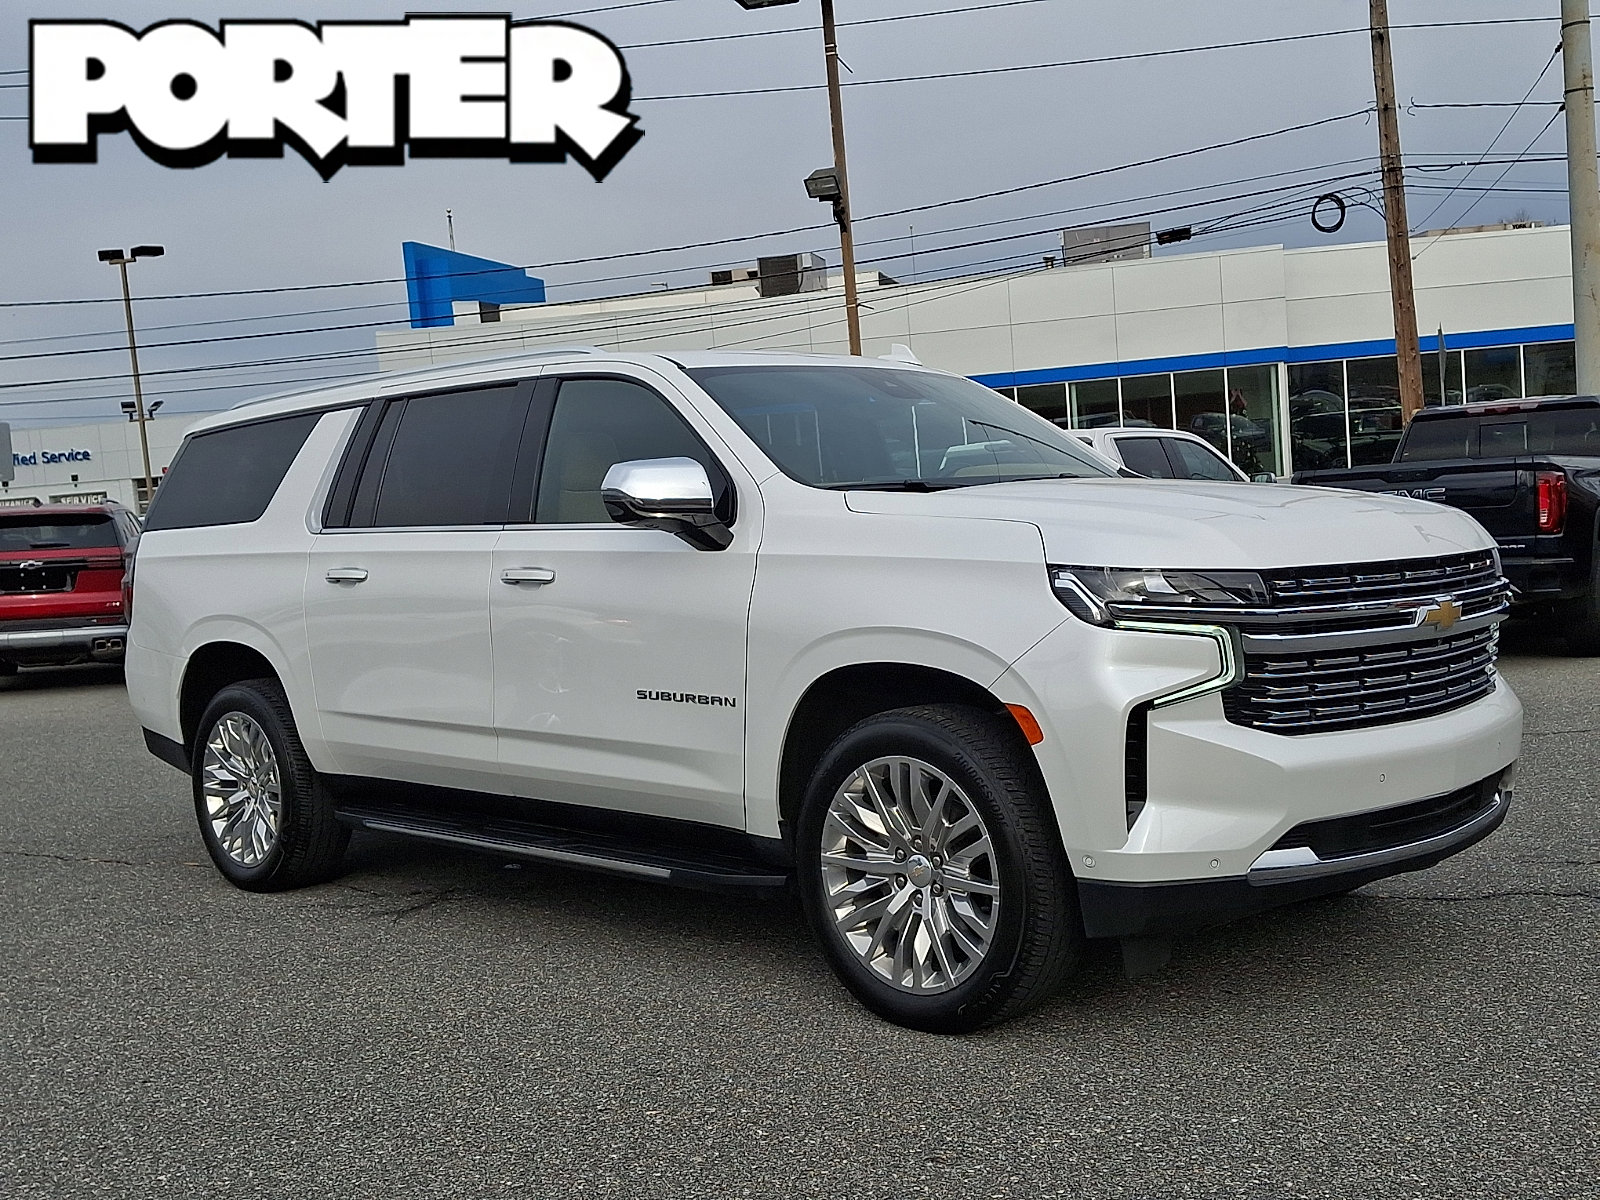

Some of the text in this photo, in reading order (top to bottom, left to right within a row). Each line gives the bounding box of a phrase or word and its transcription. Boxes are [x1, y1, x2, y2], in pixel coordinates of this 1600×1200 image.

[42, 449, 91, 464] Service
[60, 494, 103, 505] SERVICE
[636, 689, 737, 708] SUBURBAN
